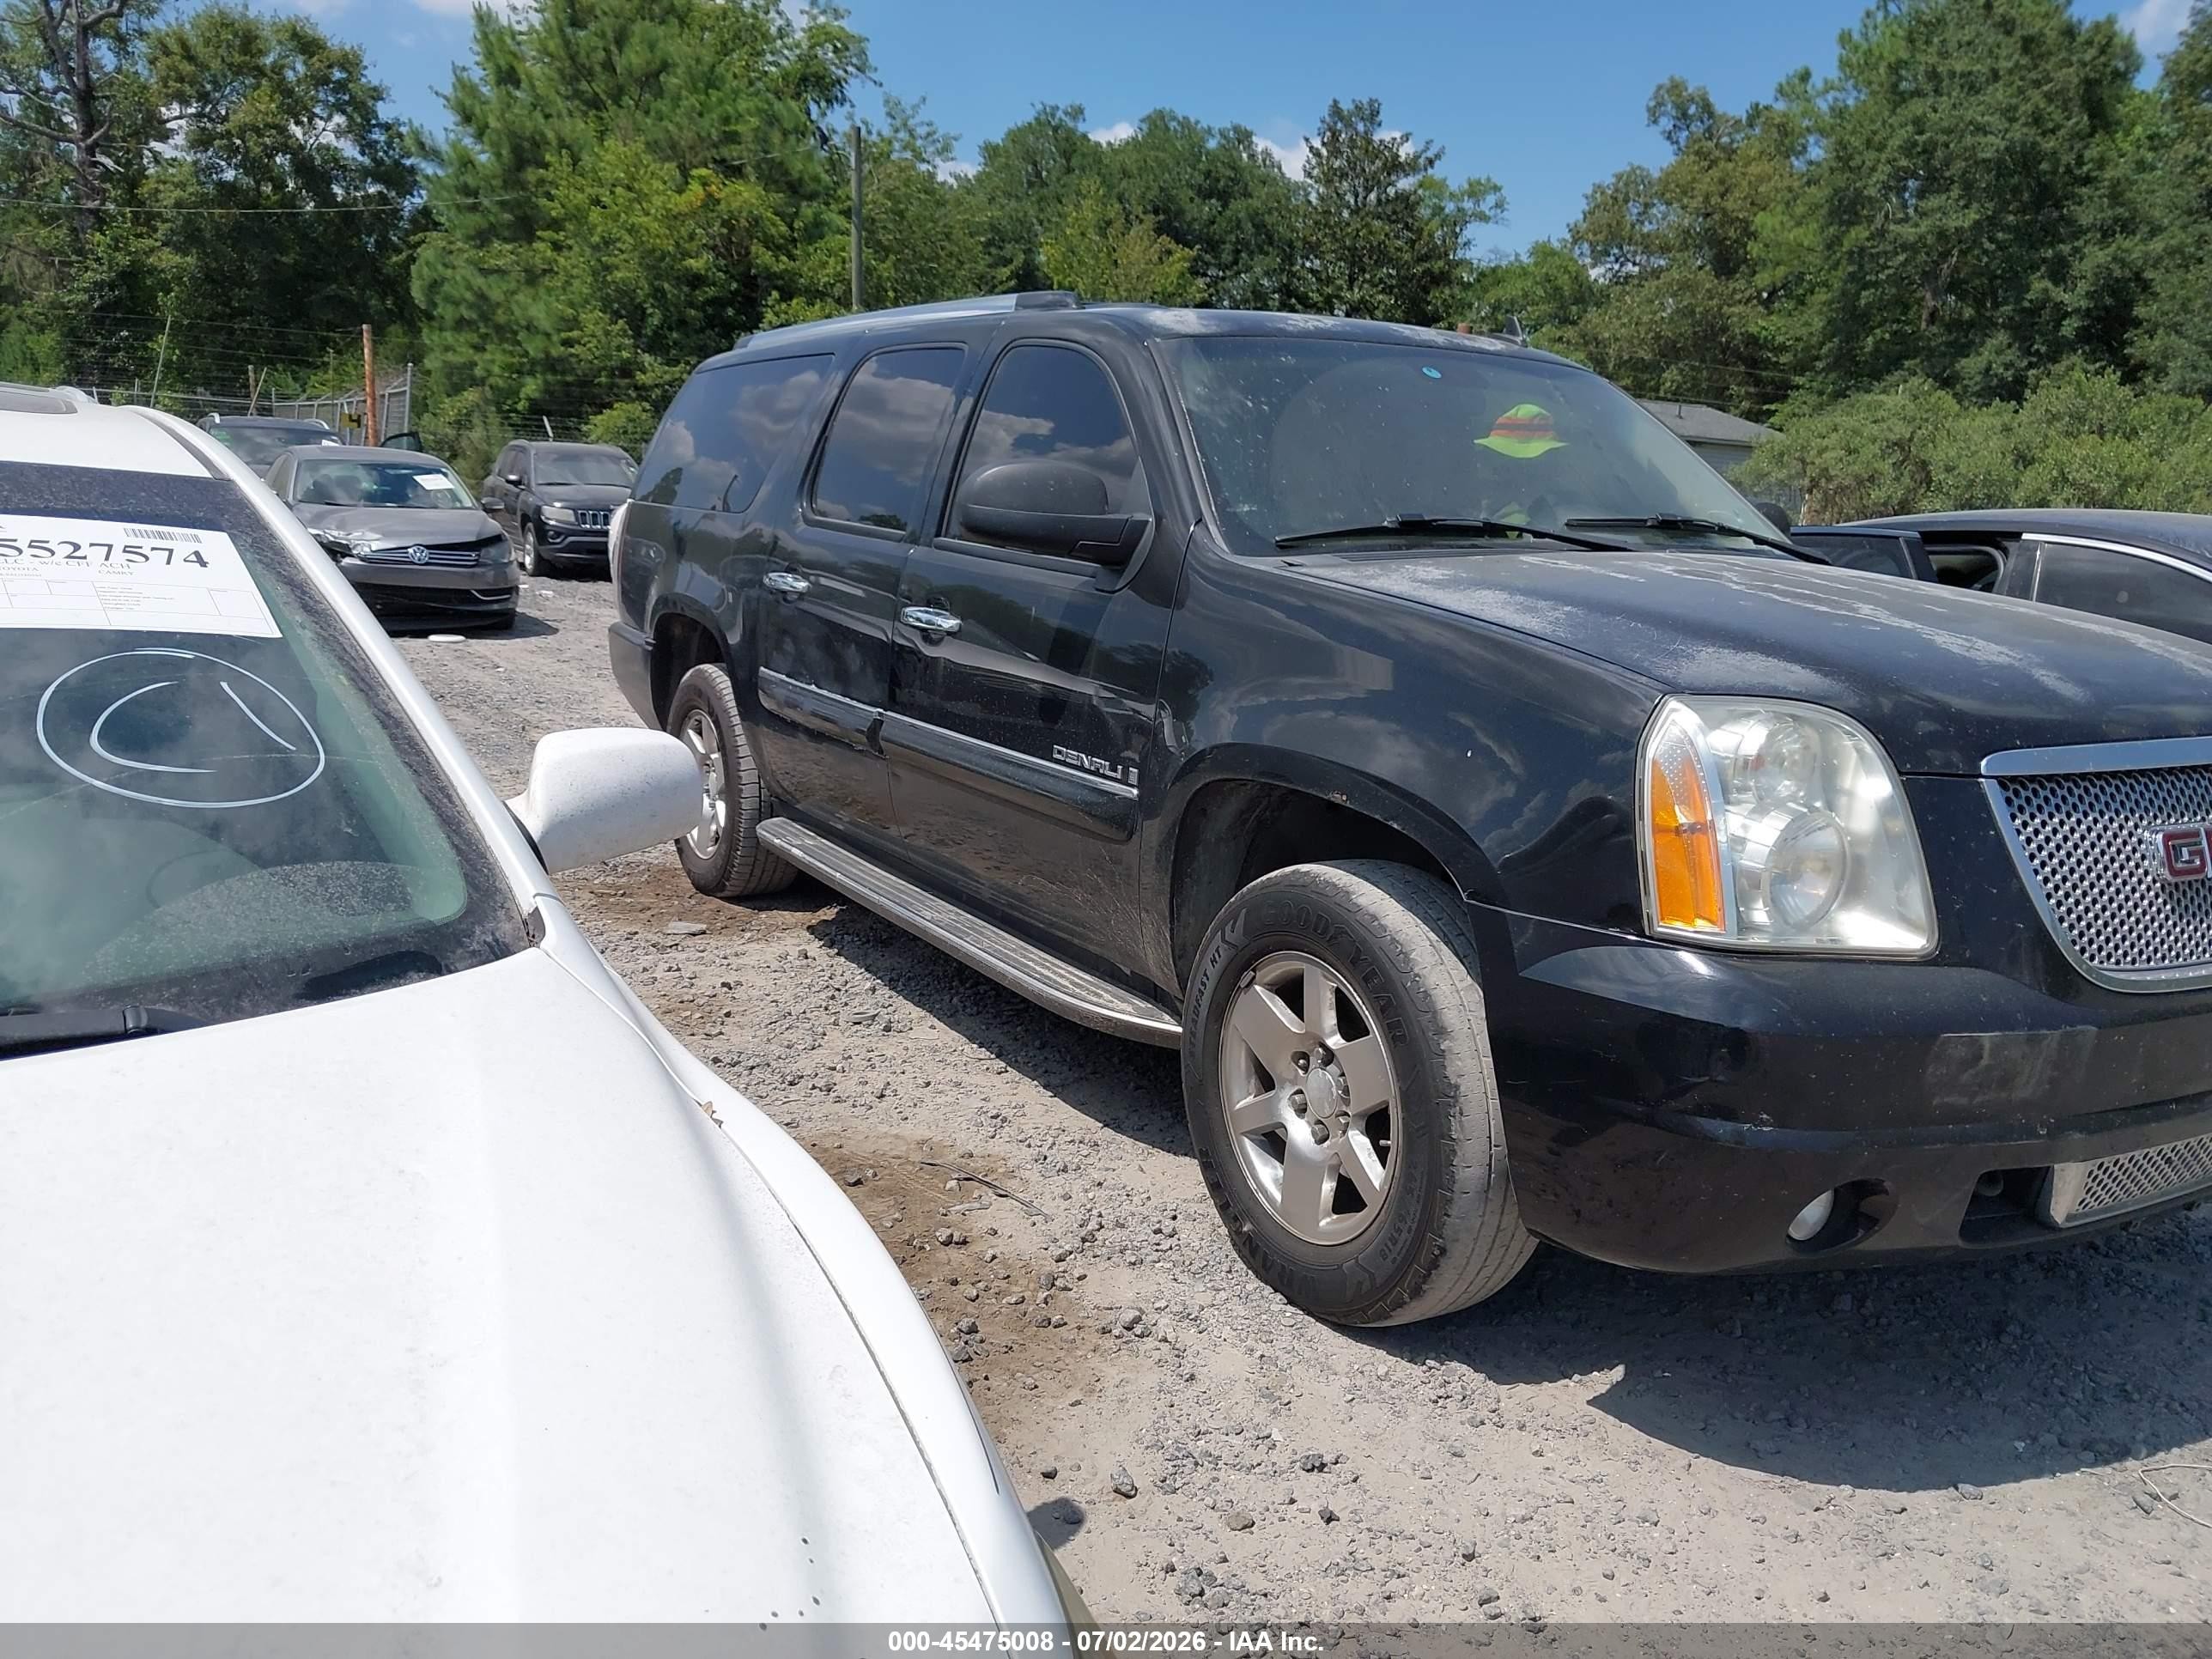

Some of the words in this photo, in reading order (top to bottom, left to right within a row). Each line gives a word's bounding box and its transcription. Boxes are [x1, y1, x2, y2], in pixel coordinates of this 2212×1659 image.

[0, 538, 210, 568] 5527574
[1052, 744, 1123, 780] DENALI
[1209, 944, 1223, 969] HT
[1261, 899, 1410, 1048] GOODYEAR
